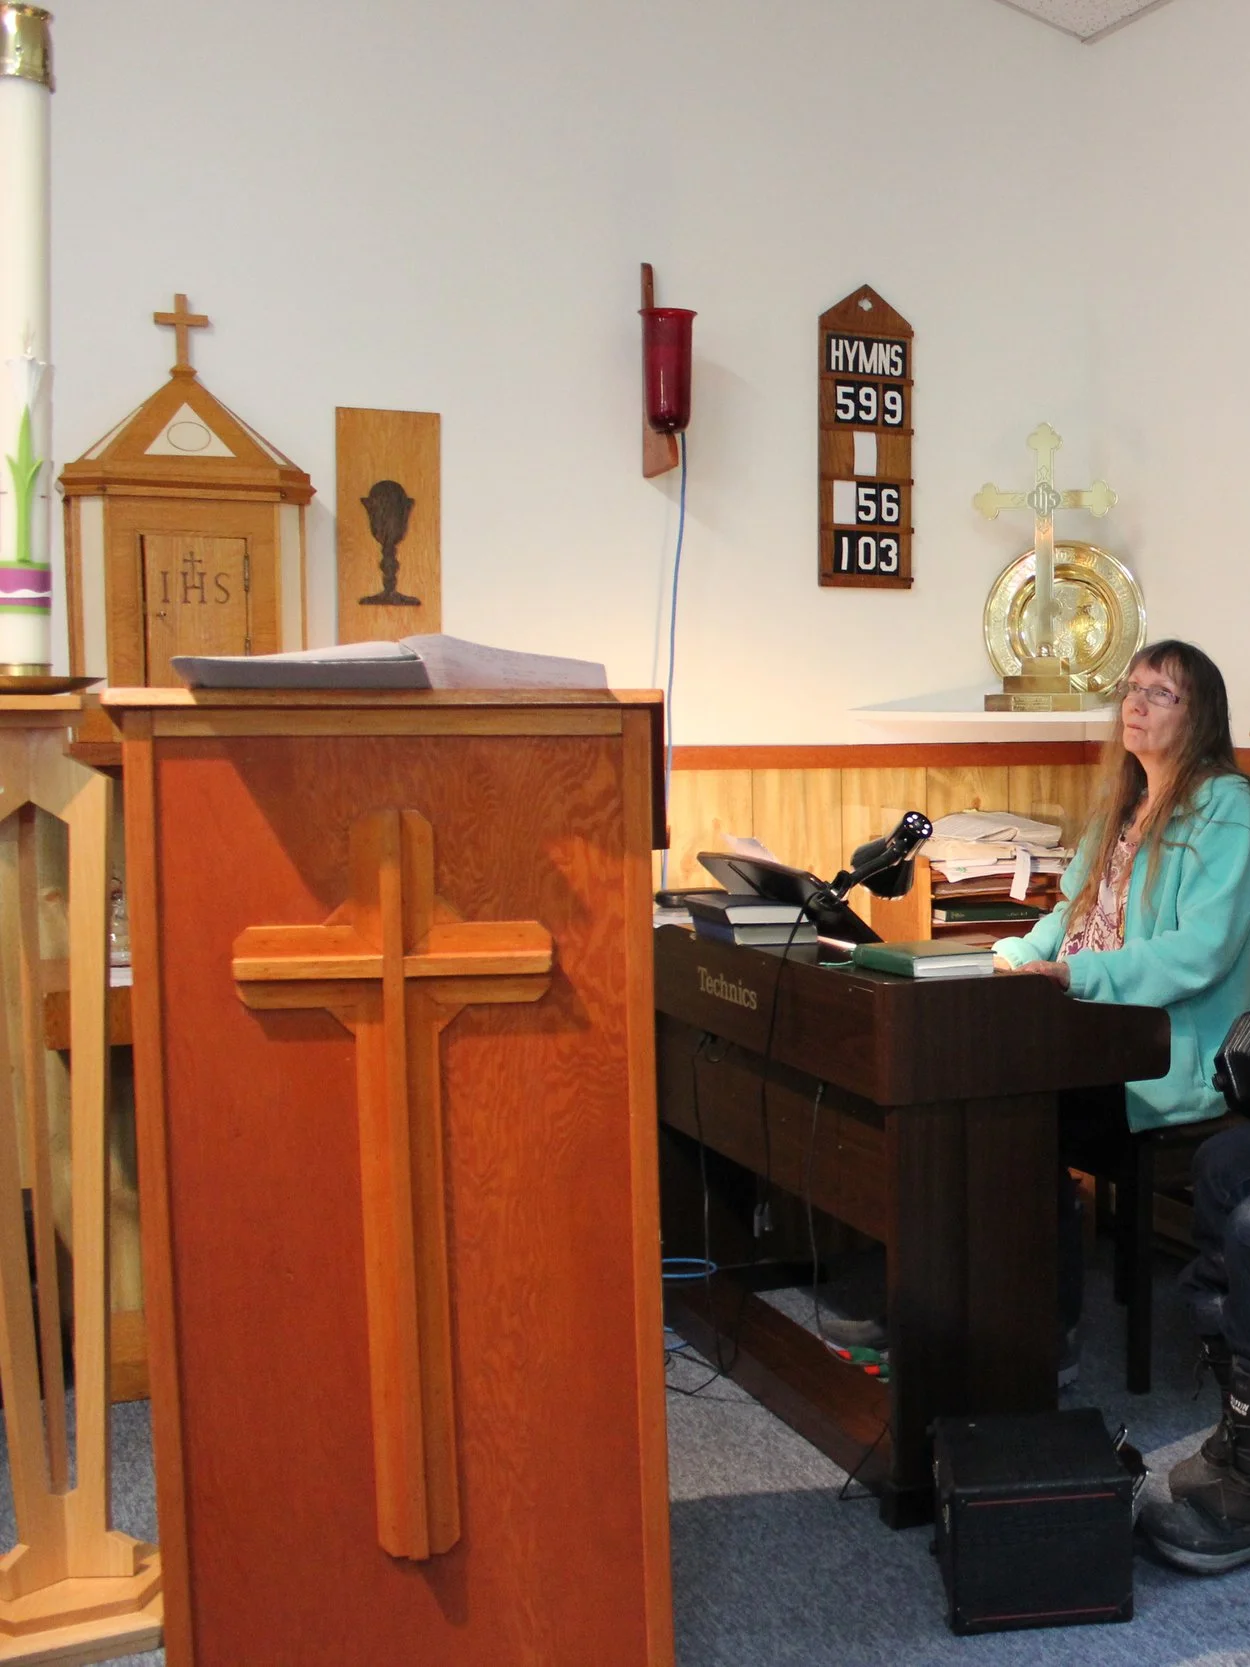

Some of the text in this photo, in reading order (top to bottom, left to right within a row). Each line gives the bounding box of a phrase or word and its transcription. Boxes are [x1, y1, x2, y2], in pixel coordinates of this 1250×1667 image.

[830, 338, 903, 377] HYMNS
[835, 385, 903, 425] 599
[857, 487, 899, 523] 56
[840, 536, 898, 573] 103
[161, 571, 230, 604] IHS
[697, 965, 757, 1010] Technics
